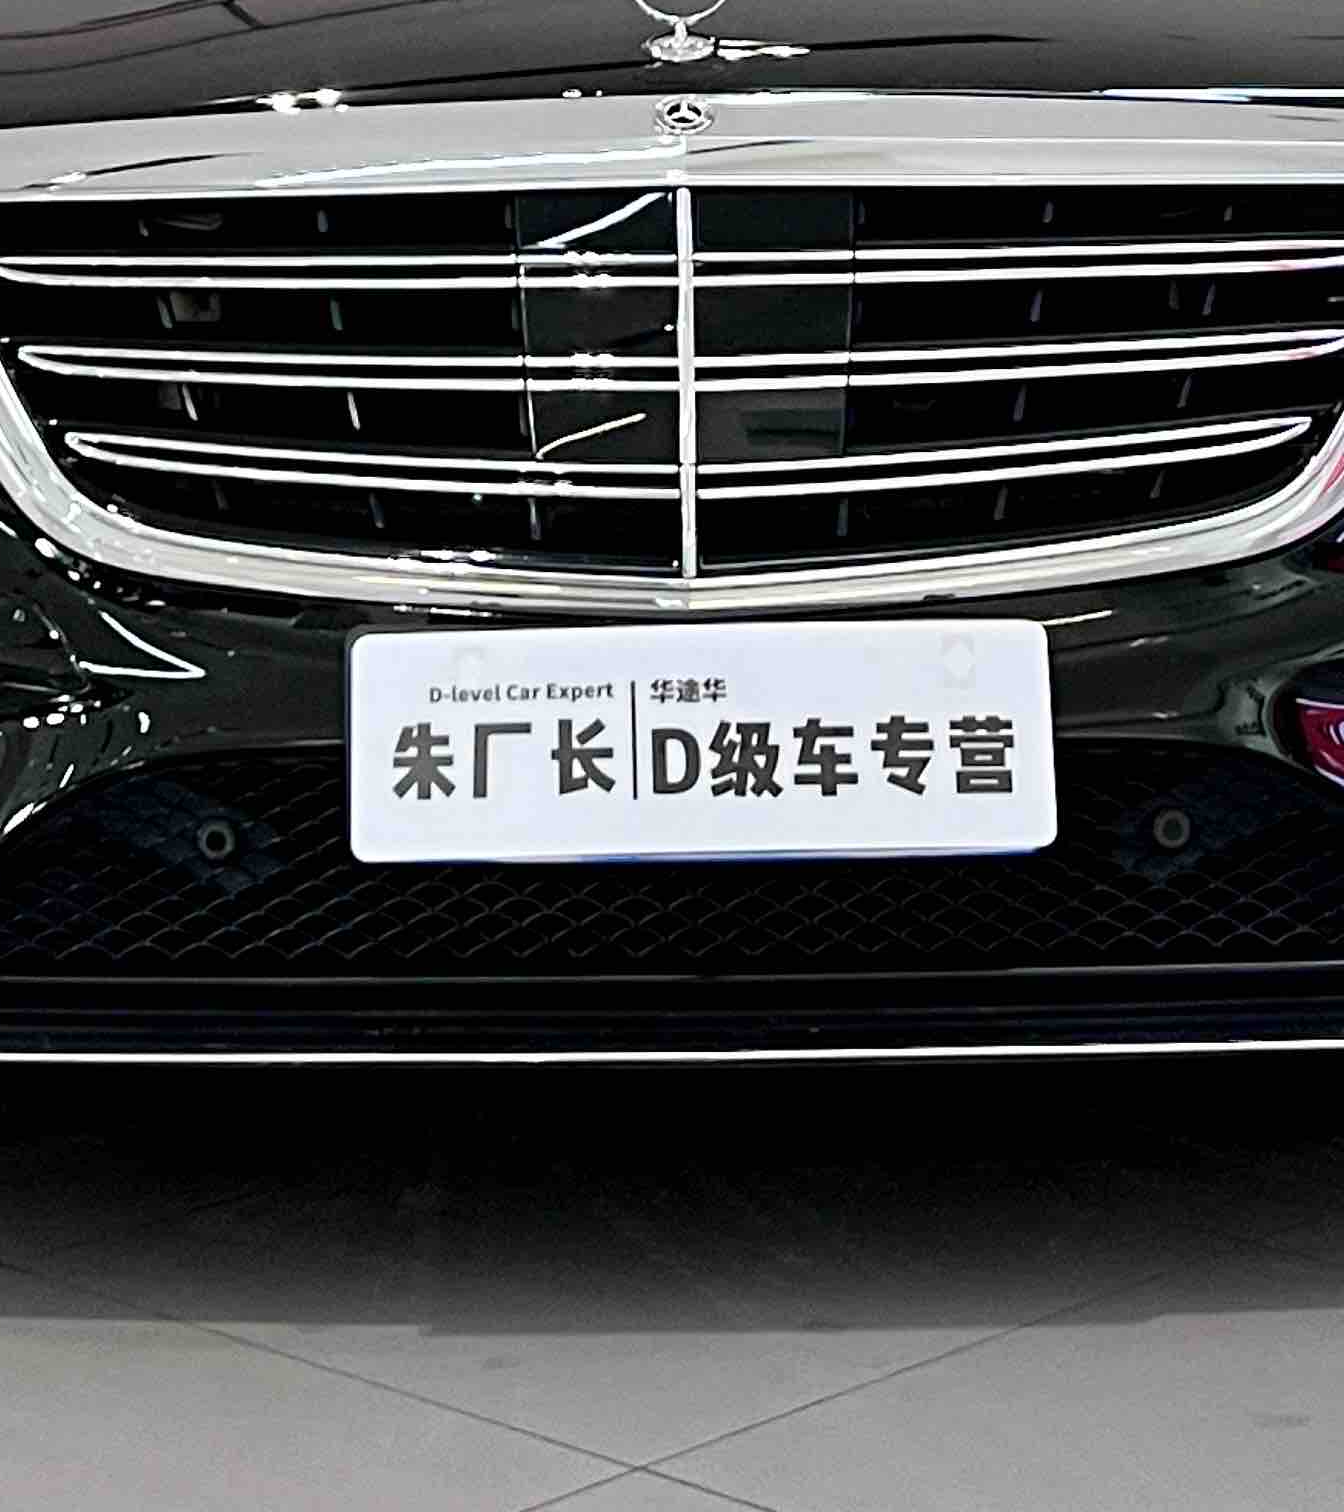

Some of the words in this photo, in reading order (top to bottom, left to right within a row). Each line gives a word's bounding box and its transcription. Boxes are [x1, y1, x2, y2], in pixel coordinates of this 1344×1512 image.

[429, 684, 501, 703] D-level
[506, 685, 540, 701] Car
[546, 682, 614, 702] Expert
[650, 678, 727, 704] 华途华
[393, 718, 616, 800] 朱厂长
[651, 715, 1015, 798] D级车专营
